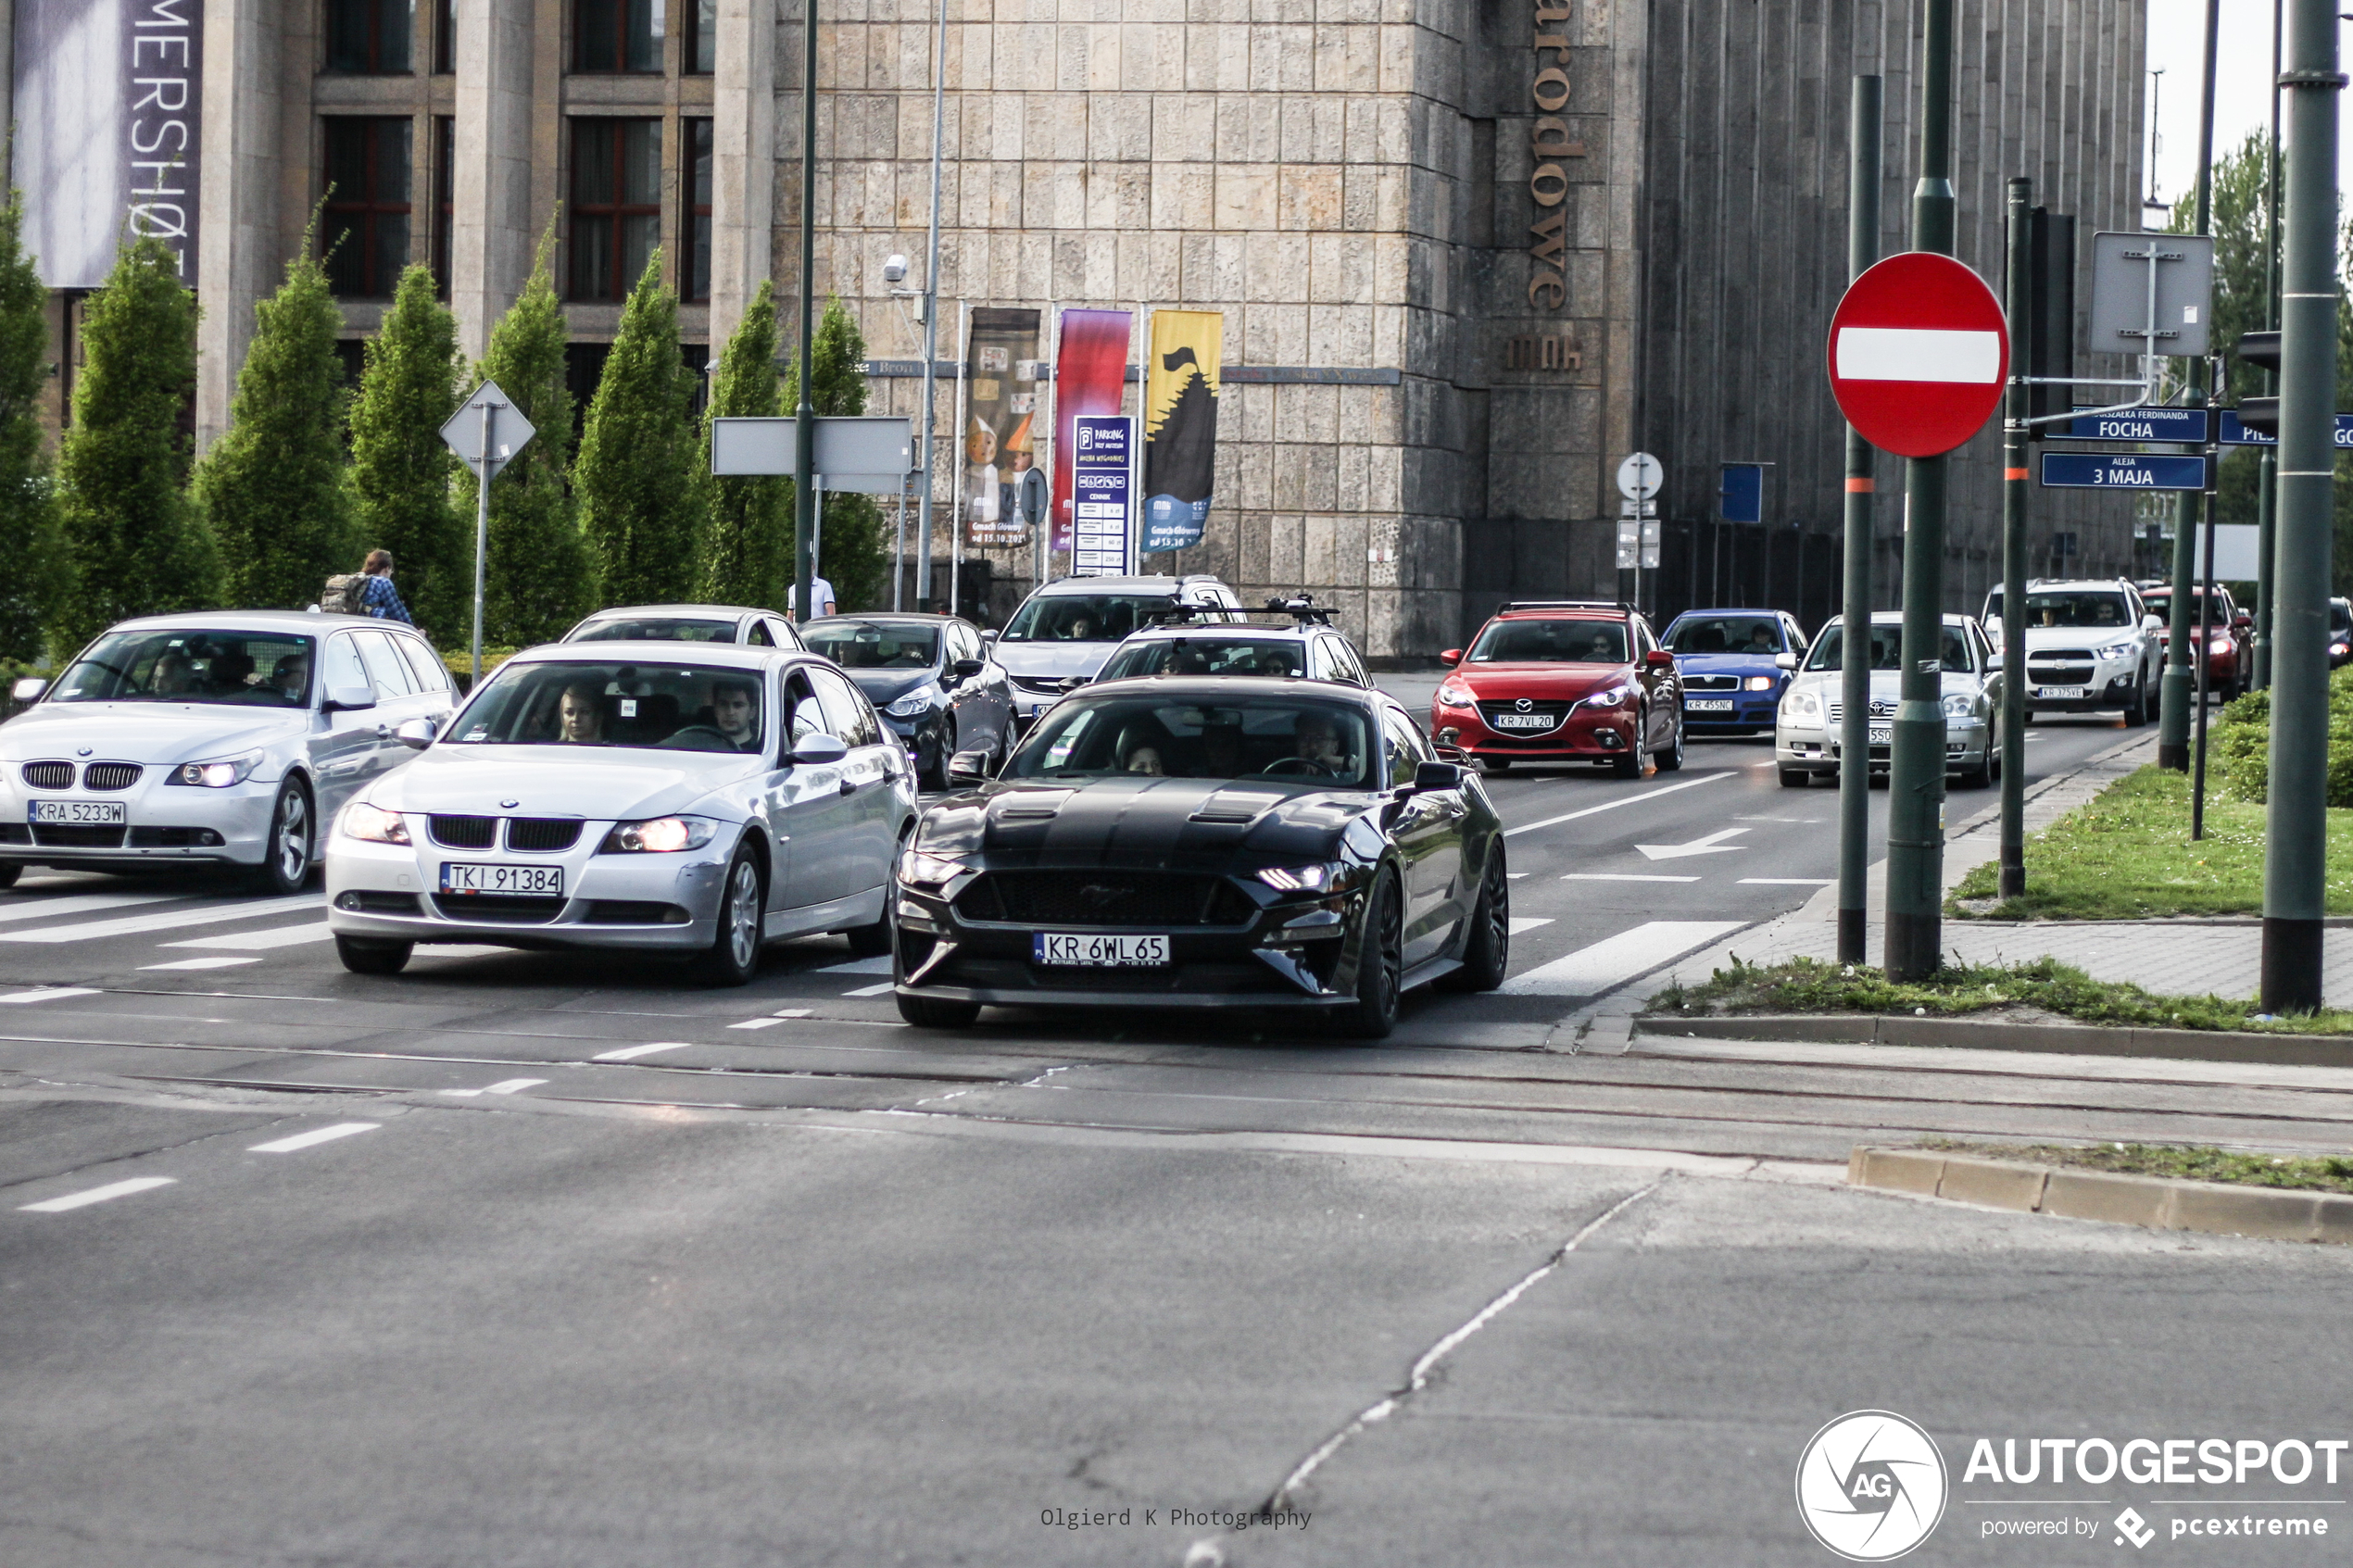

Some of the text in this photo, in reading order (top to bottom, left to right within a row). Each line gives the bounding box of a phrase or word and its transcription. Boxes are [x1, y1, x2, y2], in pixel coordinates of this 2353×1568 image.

[2138, 411, 2189, 420] FERDINANDA
[1095, 429, 1124, 440] PARKING
[2099, 421, 2154, 438] FOCHA
[2112, 458, 2136, 466] ALEJA
[2094, 469, 2154, 484] 3 MAJA
[972, 521, 1023, 533] Gmach Główny
[1151, 525, 1202, 537] Gmach Główny
[972, 533, 983, 543] od
[1150, 538, 1161, 546] od
[1689, 701, 1702, 709] KR
[1501, 716, 1515, 726] KR
[1518, 716, 1552, 727] 7VL20
[37, 804, 67, 821] KRA
[72, 804, 122, 822] 5233W
[452, 867, 484, 888] TKI
[496, 869, 560, 891] 91384
[1049, 936, 1079, 959] KR
[1088, 937, 1164, 960] 6WL65
